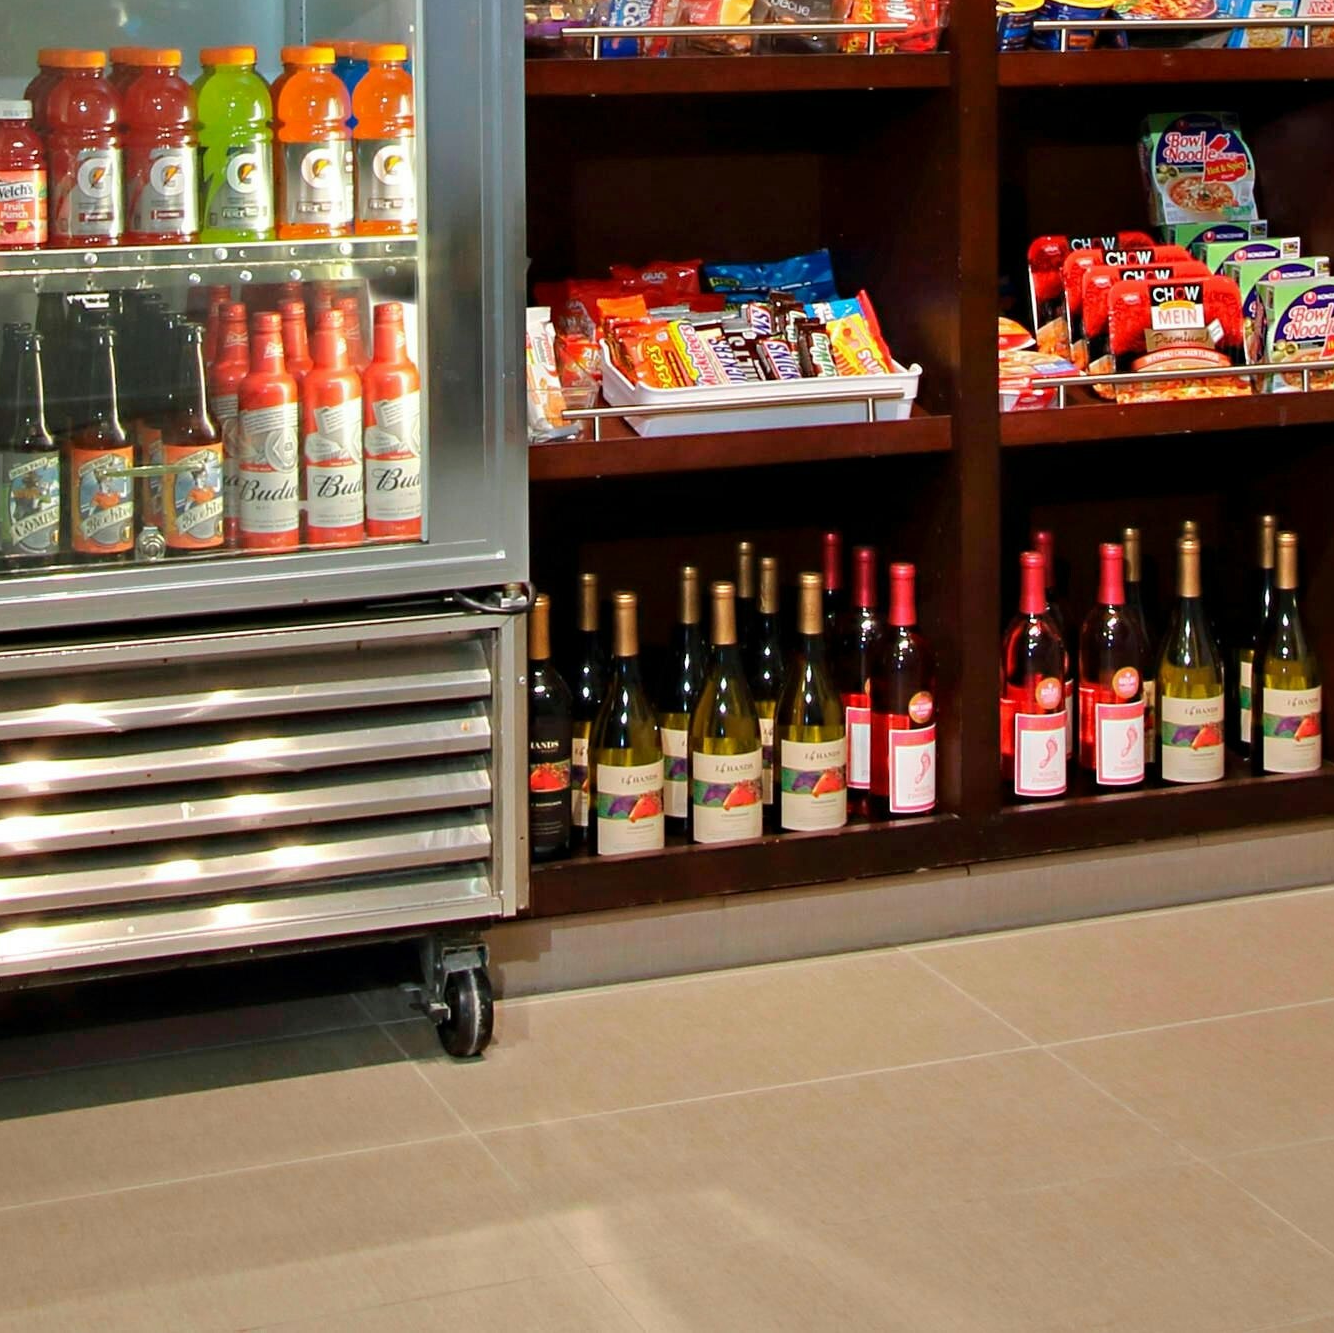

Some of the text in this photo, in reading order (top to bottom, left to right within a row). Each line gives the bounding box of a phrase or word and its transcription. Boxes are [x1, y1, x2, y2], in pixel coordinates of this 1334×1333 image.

[1165, 131, 1206, 148] Bowl
[1162, 146, 1216, 164] Noodle
[1071, 236, 1116, 251] CHOW
[1105, 251, 1152, 266] CHOW
[1152, 285, 1200, 303] CHOW
[1158, 307, 1198, 325] MEIN
[1289, 303, 1333, 323] Bowl
[1152, 330, 1208, 347] Premium
